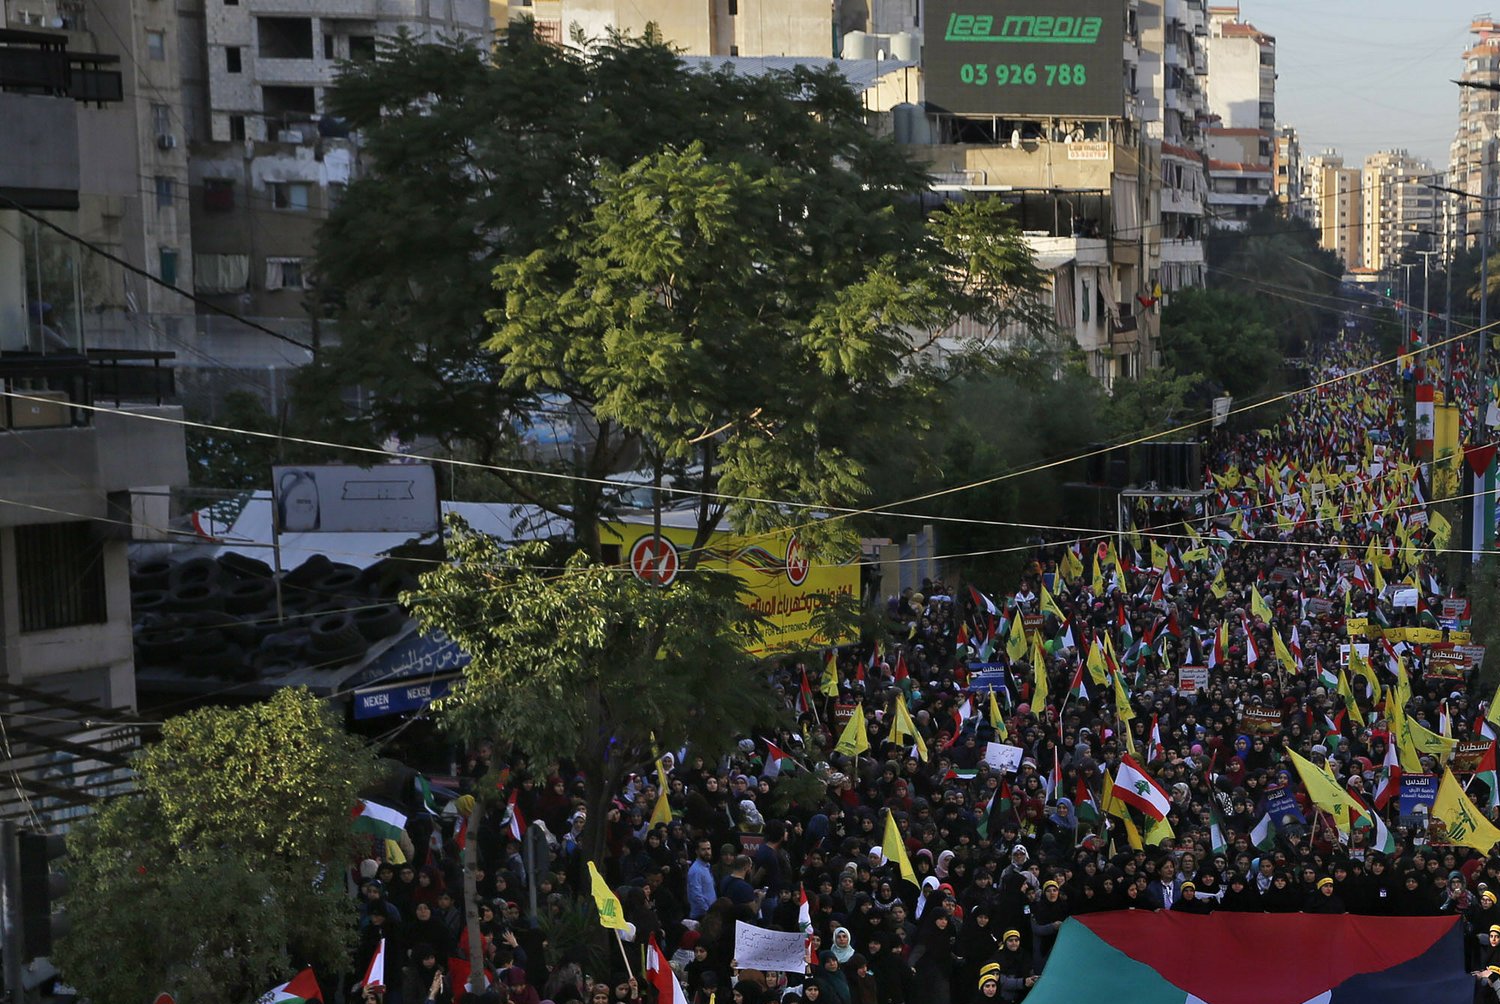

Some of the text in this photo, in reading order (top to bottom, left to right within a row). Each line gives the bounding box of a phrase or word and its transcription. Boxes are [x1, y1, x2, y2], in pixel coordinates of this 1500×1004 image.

[960, 64, 1086, 86] 03 926 788
[1432, 651, 1463, 661] فلسطين
[407, 686, 431, 699] NEXEN
[363, 693, 389, 708] NEXEN
[1246, 708, 1281, 719] فلسطين
[1405, 776, 1430, 786] القدس
